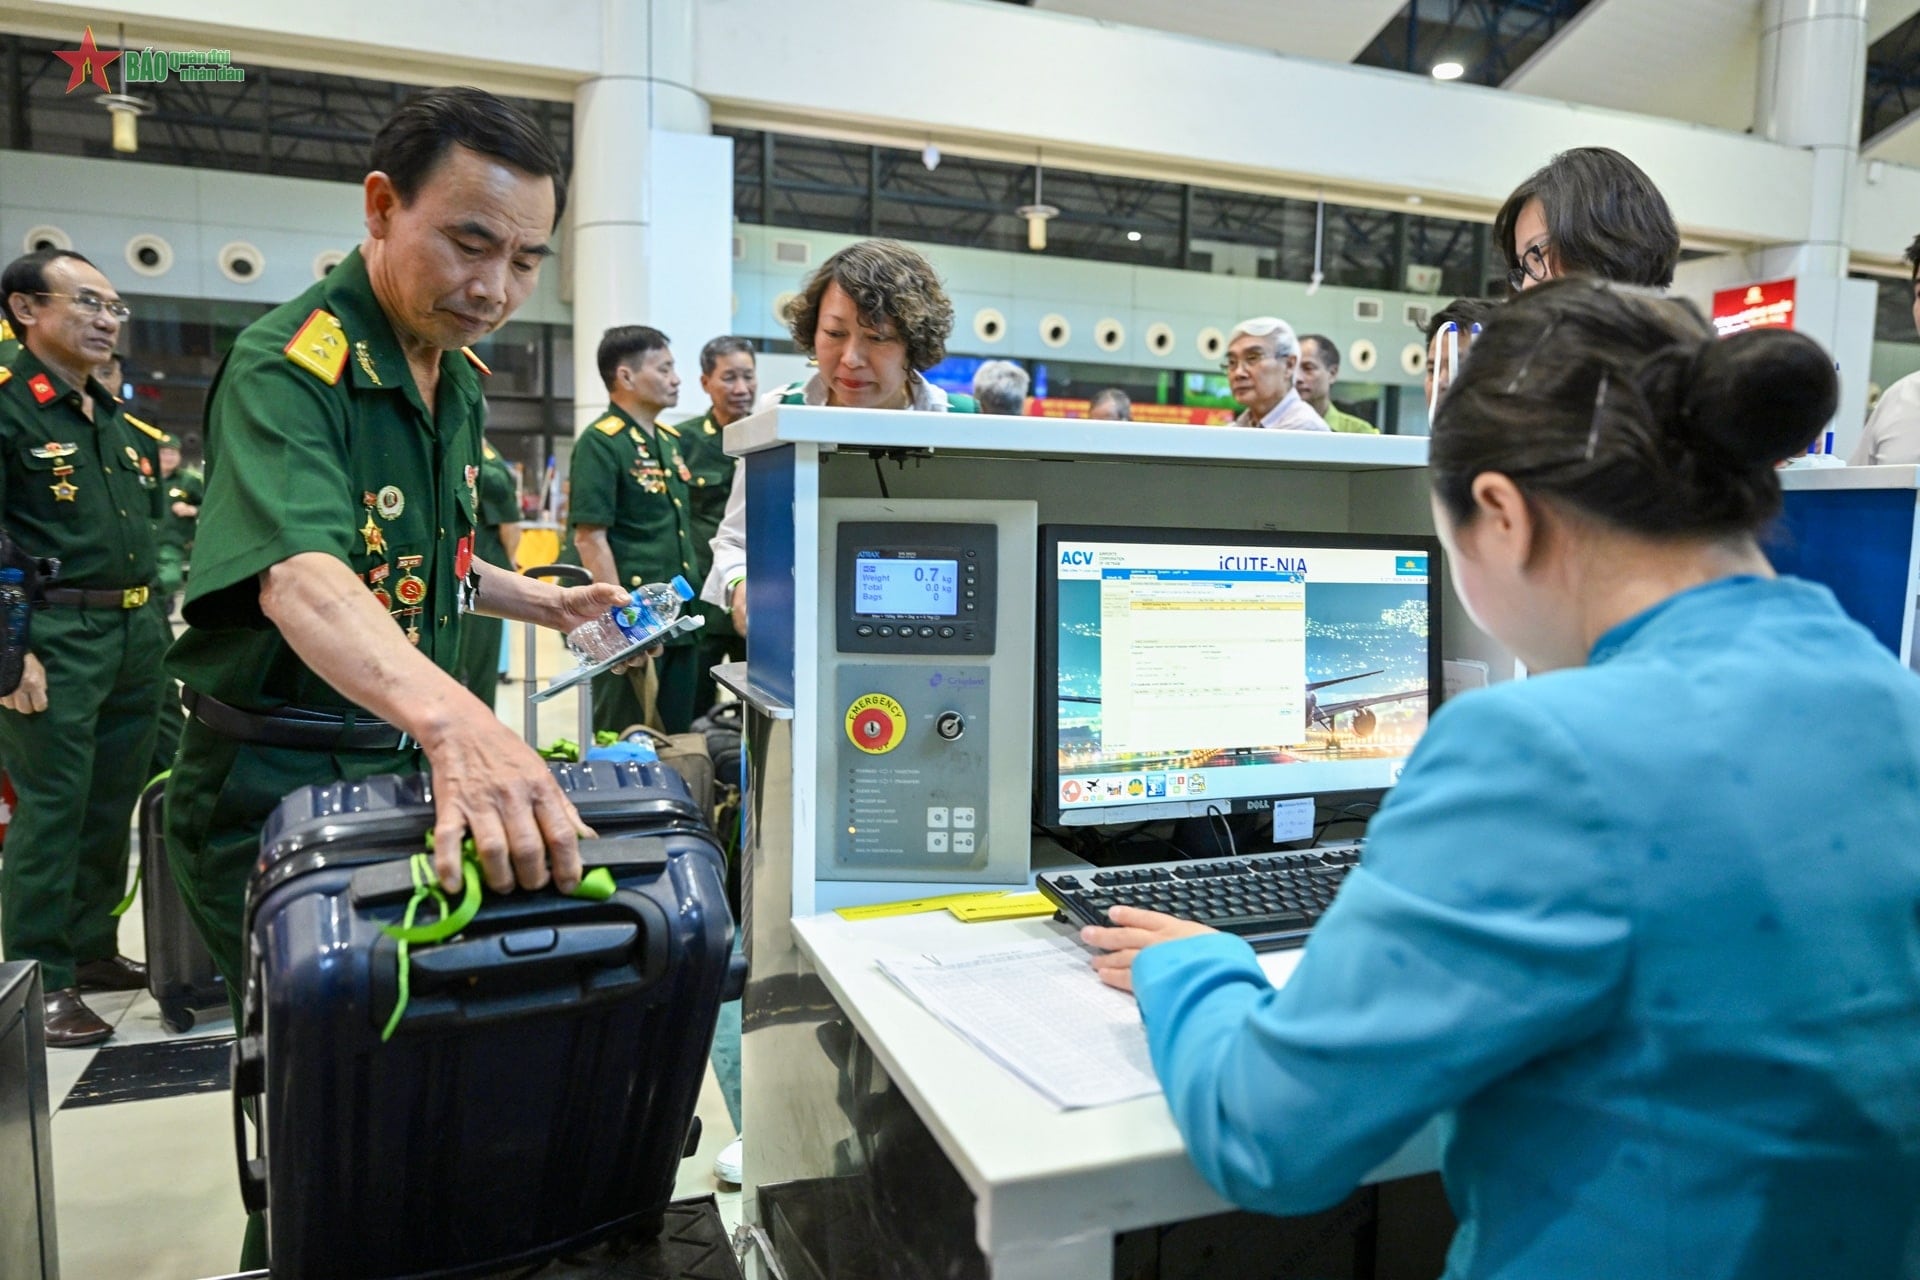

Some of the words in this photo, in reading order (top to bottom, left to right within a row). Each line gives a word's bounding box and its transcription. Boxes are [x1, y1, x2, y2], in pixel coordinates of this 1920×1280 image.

[1061, 551, 1093, 565] ACV
[862, 574, 890, 582] Weight
[914, 567, 939, 582] 0.7
[942, 576, 952, 584] kg
[863, 583, 883, 591] Total
[925, 583, 939, 592] 0.0
[942, 585, 952, 593] kg
[863, 593, 883, 602] Bags
[933, 593, 939, 601] 0
[849, 696, 902, 721] EMERGENCY
[1247, 800, 1270, 810] DELL
